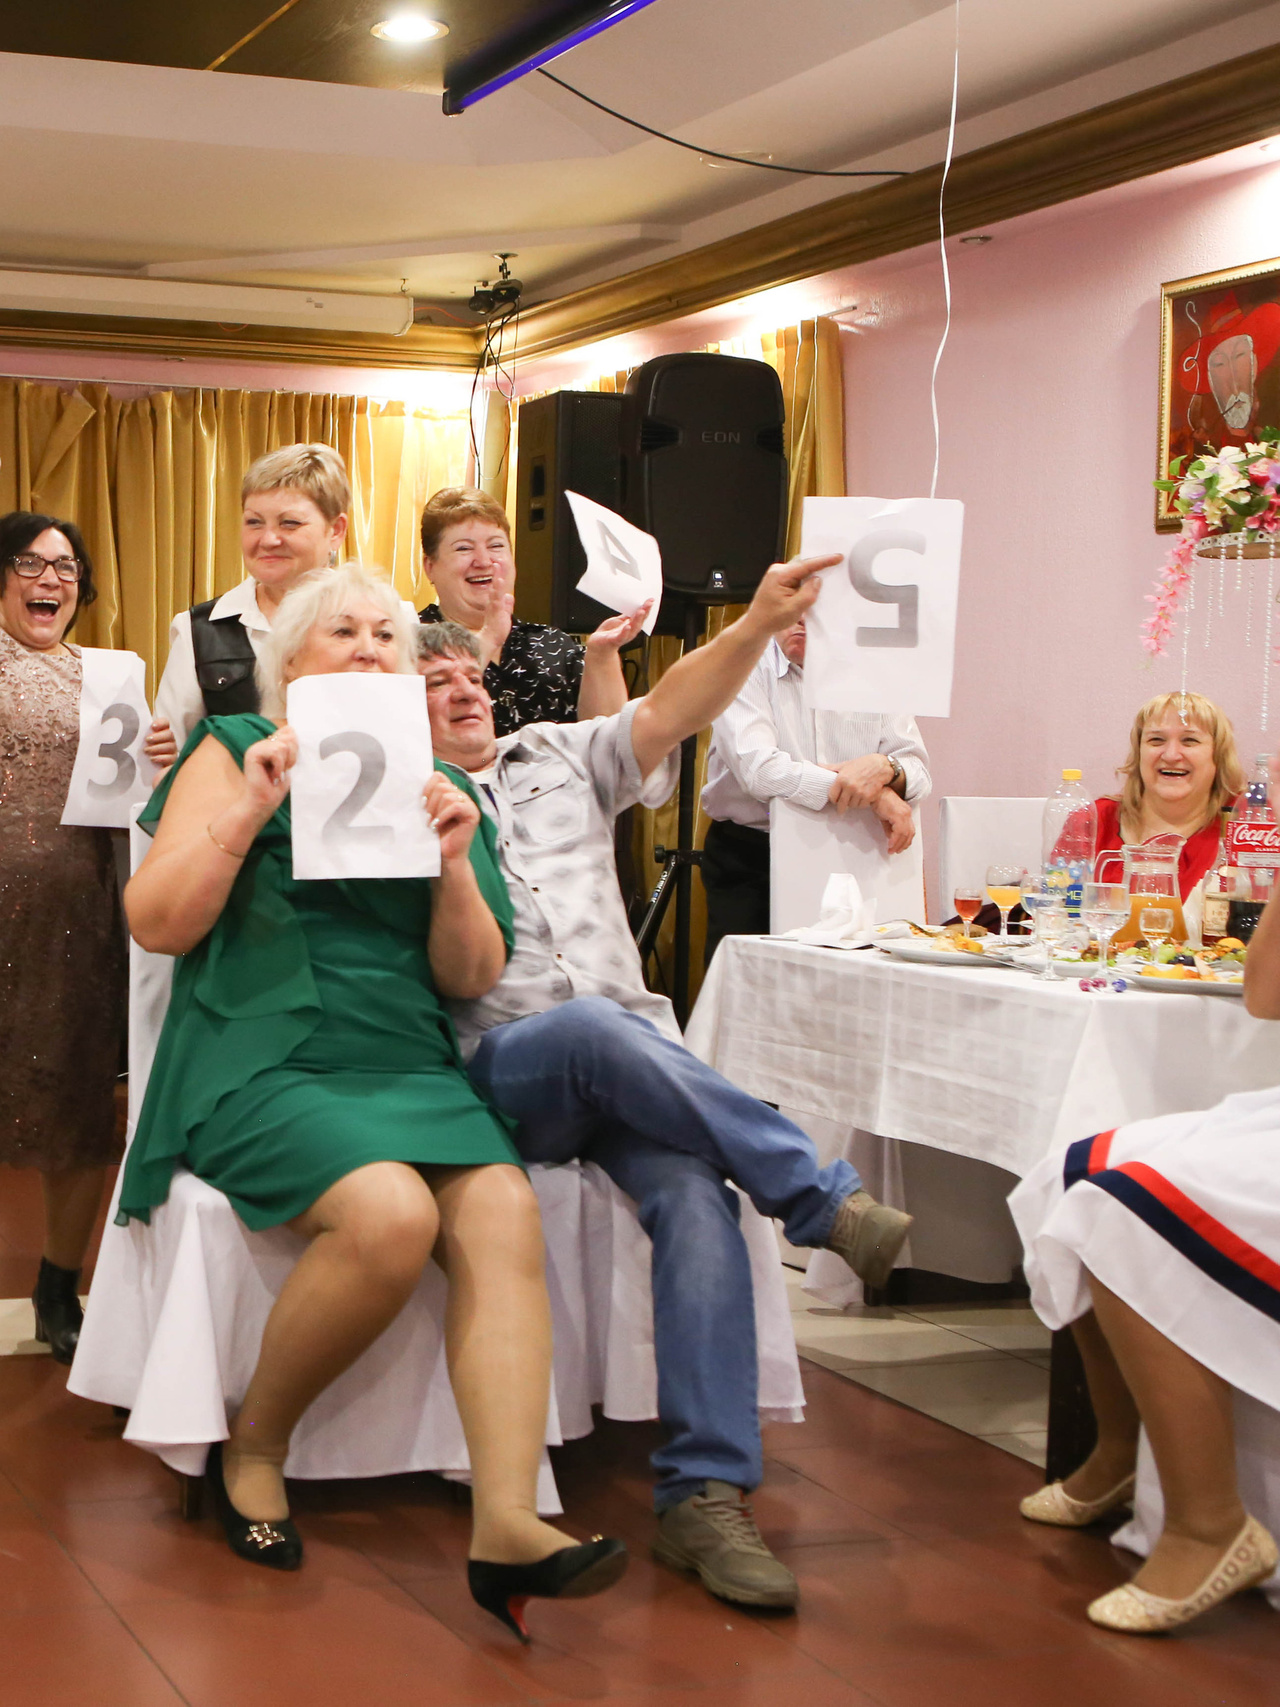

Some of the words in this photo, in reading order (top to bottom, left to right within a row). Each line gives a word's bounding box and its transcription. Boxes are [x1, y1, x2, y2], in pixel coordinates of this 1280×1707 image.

[701, 431, 740, 443] EON
[596, 519, 642, 581] 4
[848, 529, 927, 648] 5
[86, 703, 140, 800] 3
[319, 731, 396, 846] 2
